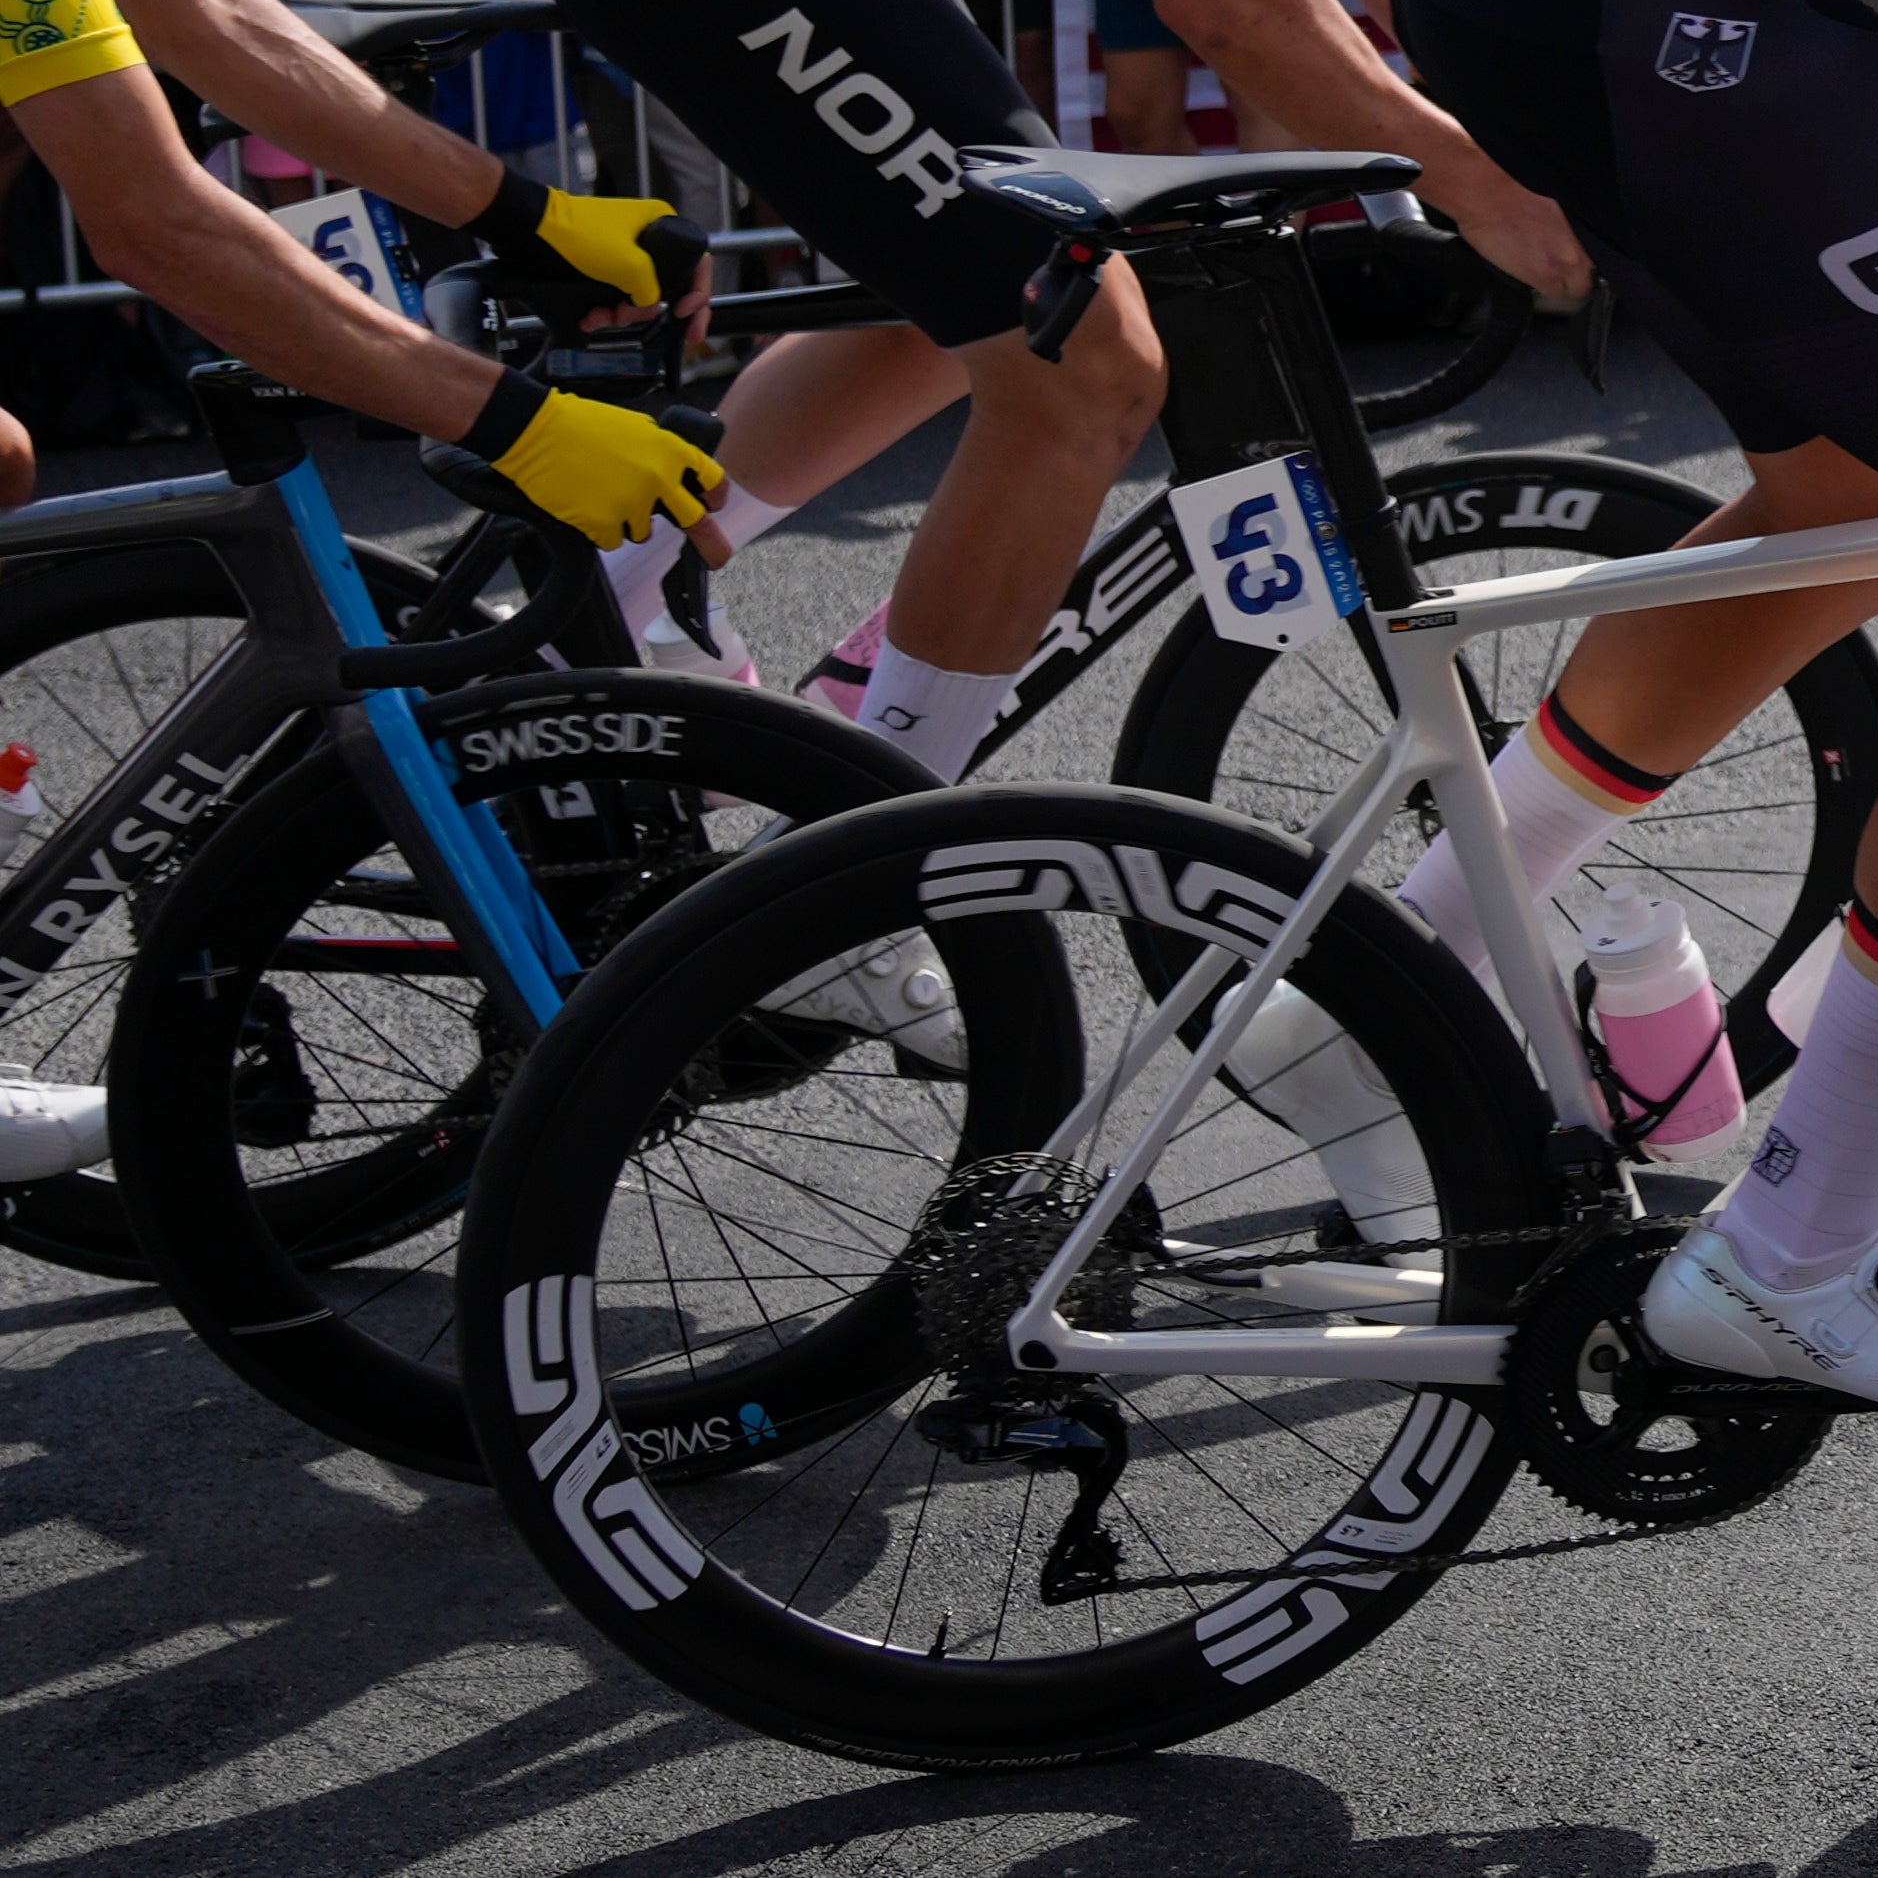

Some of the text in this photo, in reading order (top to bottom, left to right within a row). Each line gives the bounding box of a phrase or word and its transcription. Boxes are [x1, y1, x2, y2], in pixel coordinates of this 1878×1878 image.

[738, 6, 965, 220] NOR
[998, 183, 1088, 215] prologo
[1210, 492, 1304, 616] 43
[1501, 488, 1603, 532] DT
[462, 712, 686, 773] SWISS SIDE
[32, 748, 250, 944] RYSEL
[1700, 1266, 1840, 1373] SPHYRE
